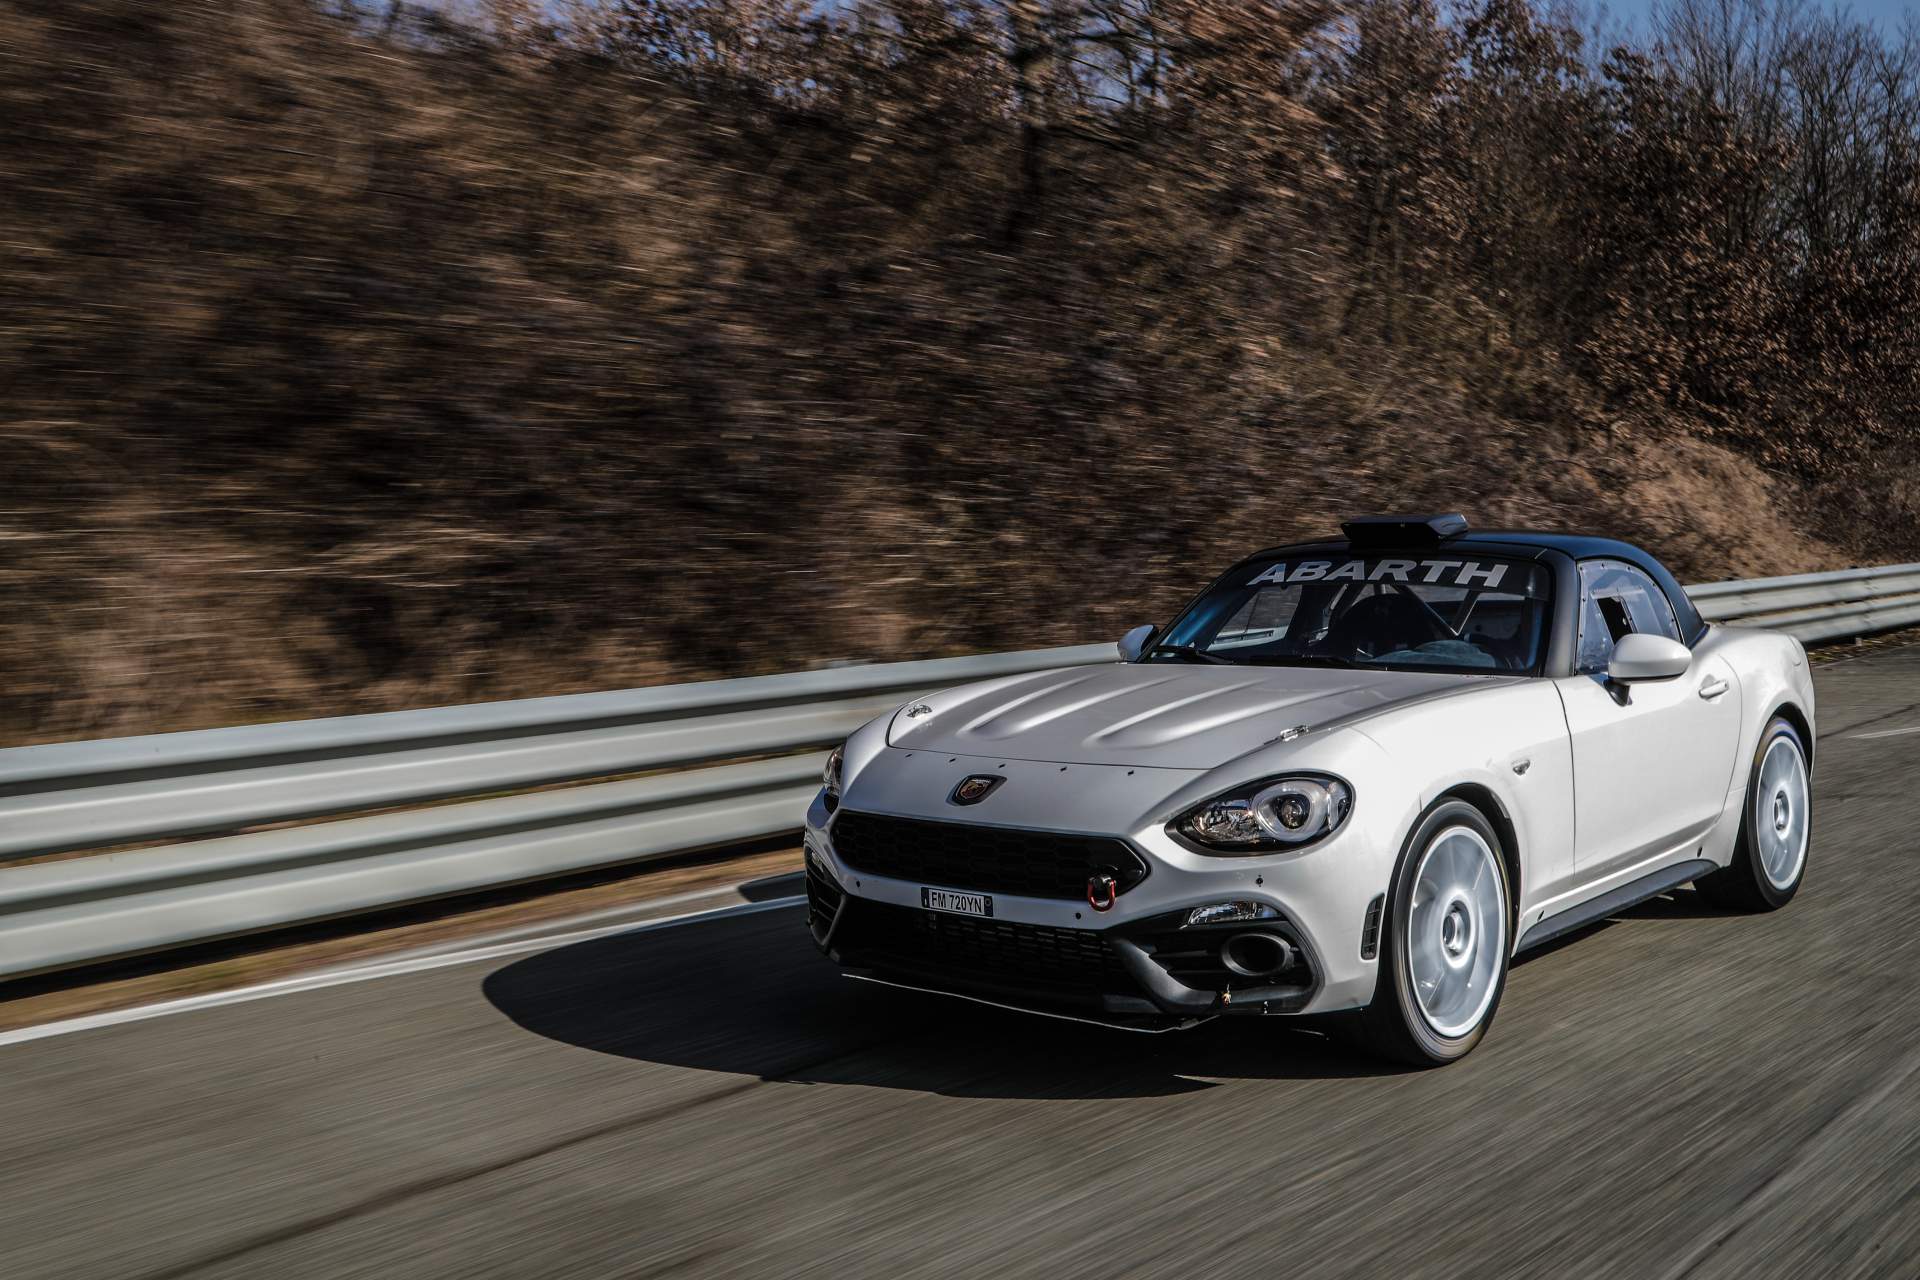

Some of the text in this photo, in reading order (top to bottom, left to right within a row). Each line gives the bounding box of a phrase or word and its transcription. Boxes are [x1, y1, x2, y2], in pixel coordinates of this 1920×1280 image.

[1246, 559, 1509, 588] ABARTH
[931, 892, 946, 908] FM
[949, 894, 982, 912] 720YN
